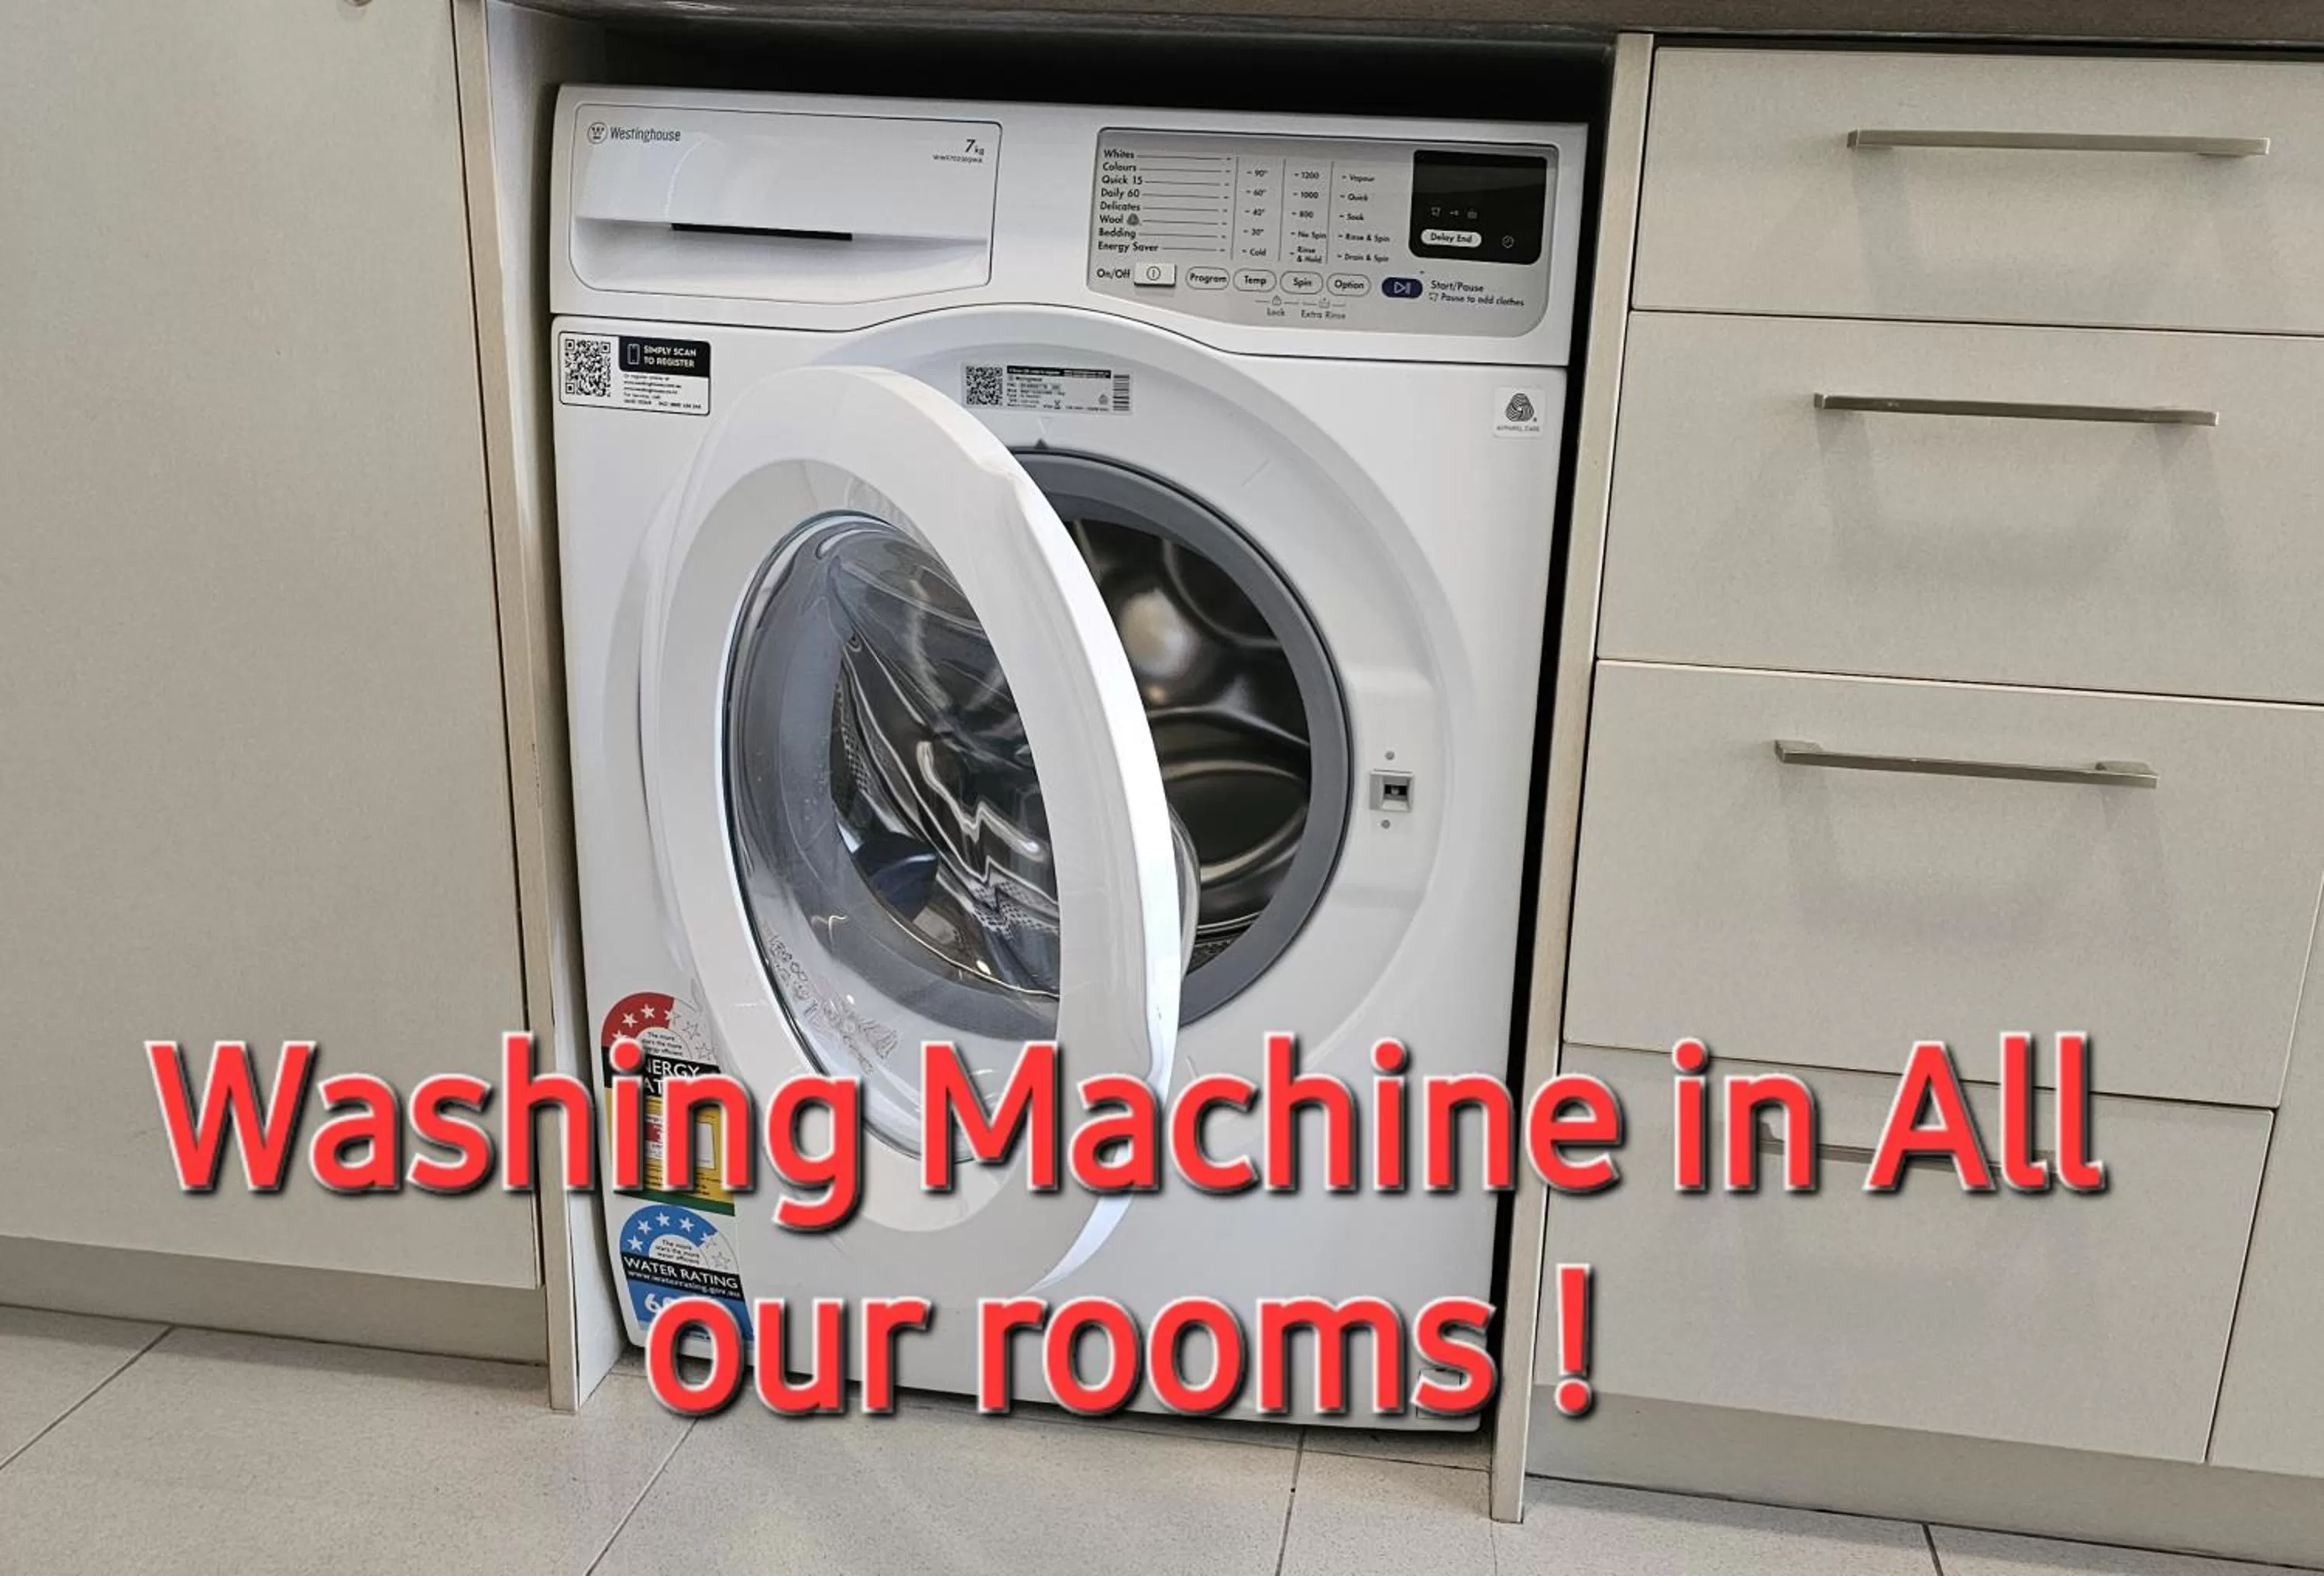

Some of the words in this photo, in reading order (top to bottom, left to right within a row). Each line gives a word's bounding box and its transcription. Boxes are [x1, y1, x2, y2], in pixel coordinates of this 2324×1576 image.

[610, 126, 681, 143] Westinghouse
[1104, 149, 1134, 159] Whites
[1102, 162, 1136, 171] Colours
[1101, 174, 1128, 184] Quick
[1133, 175, 1143, 184] 15
[1301, 171, 1319, 180] 1200
[1349, 174, 1375, 183] Vapour
[1101, 188, 1124, 200] Daily
[1127, 188, 1140, 198] 60
[1347, 193, 1368, 201] Quick
[1099, 201, 1140, 211] Delicates
[1098, 214, 1123, 224] Wool
[1346, 212, 1364, 221] Soak
[1098, 227, 1136, 239] Bedding
[1311, 231, 1327, 240] Spin
[1373, 233, 1390, 243] Spin
[1430, 232, 1453, 243] Delay
[1456, 232, 1473, 243] End
[1098, 241, 1129, 253] Energy
[1133, 242, 1159, 252] Saver
[1250, 247, 1267, 256] Cold
[1096, 269, 1130, 280] On/Off
[1189, 272, 1227, 284] Program
[1244, 274, 1267, 286] Temp
[1293, 276, 1312, 287] Spin
[1334, 280, 1364, 291] Option
[1430, 280, 1484, 292] Start/Pause
[1441, 293, 1465, 302] Pause
[1477, 295, 1494, 305] add
[1496, 296, 1525, 306] clothes
[1267, 308, 1285, 317] Lock
[1301, 309, 1322, 318] Extra
[1325, 311, 1346, 320] Rinse
[644, 345, 672, 356] SIMPLY
[673, 346, 696, 357] SCAN
[644, 356, 655, 366] TO
[656, 357, 695, 369] REGISTER
[662, 1239, 673, 1247] The
[623, 1255, 676, 1279] WATER
[679, 1268, 739, 1289] RATING
